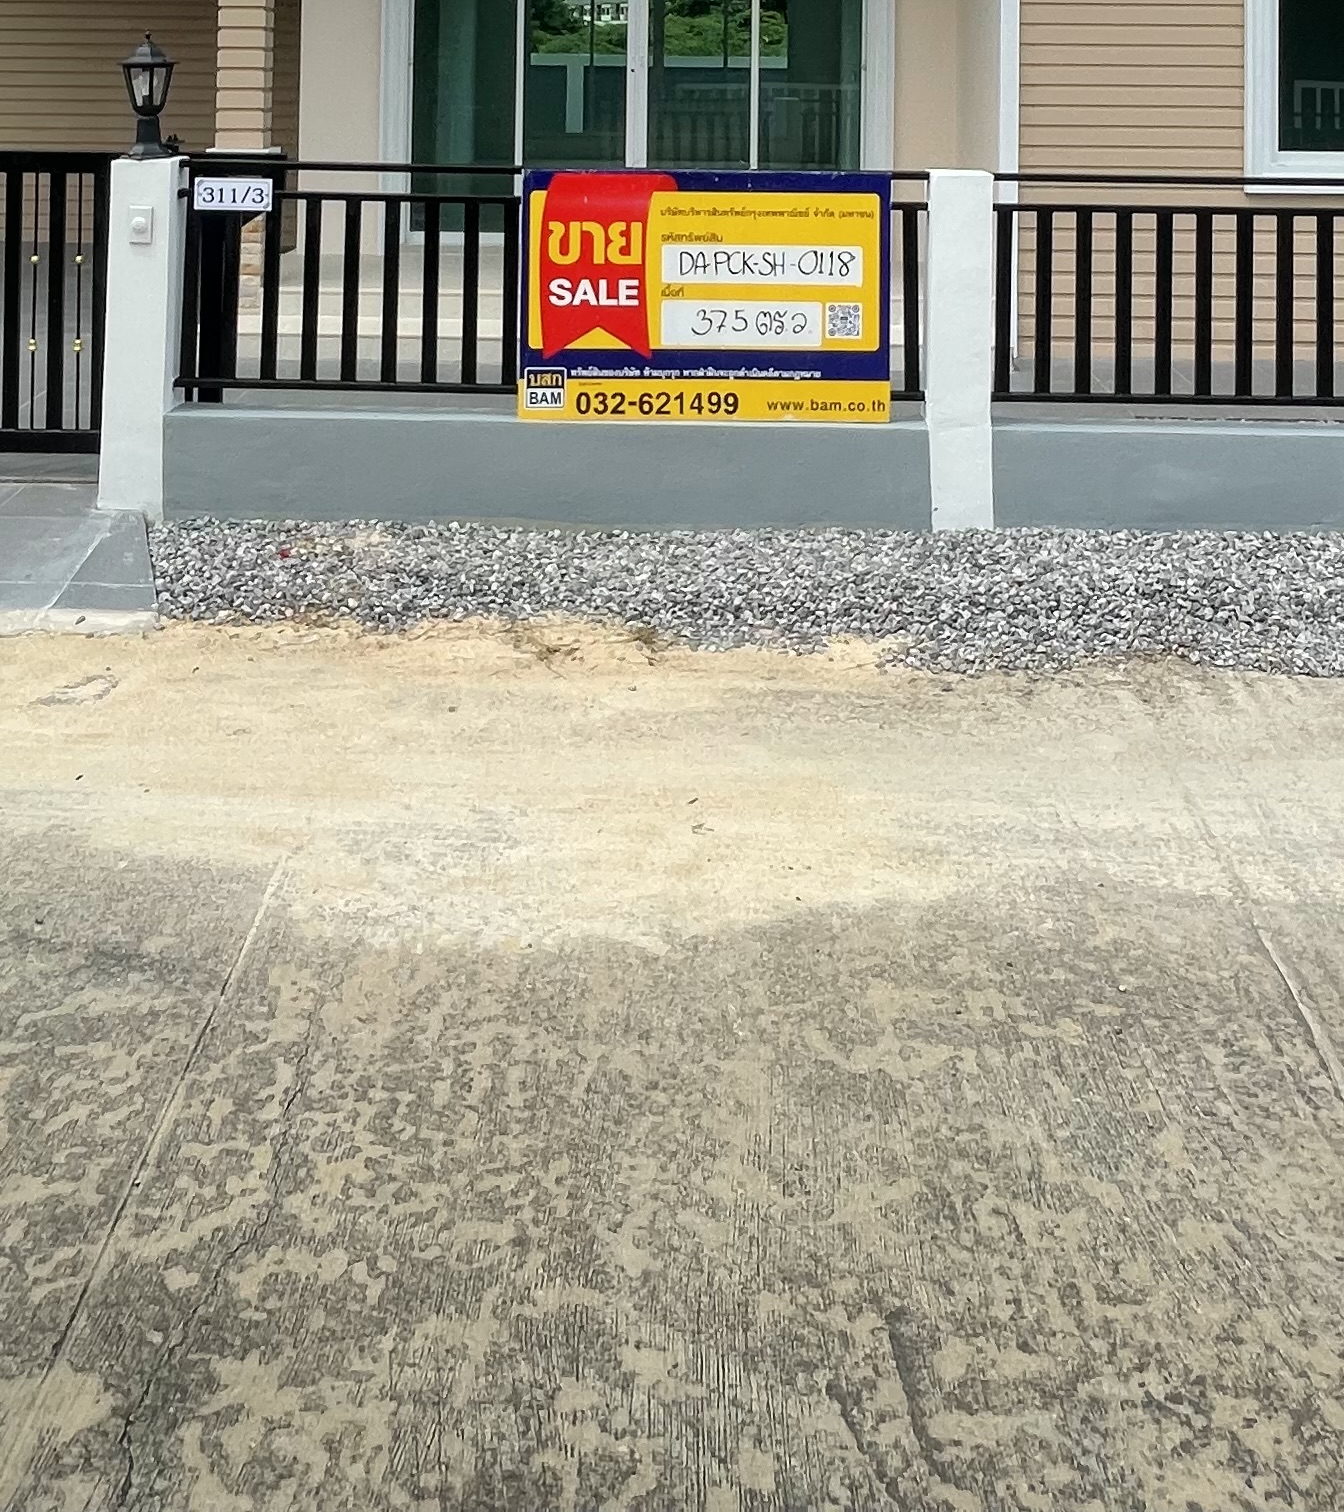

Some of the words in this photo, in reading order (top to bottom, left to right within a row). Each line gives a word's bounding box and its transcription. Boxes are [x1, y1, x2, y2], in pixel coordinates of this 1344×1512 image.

[202, 186, 265, 204] 311/3
[549, 221, 642, 265] ขาย
[549, 279, 639, 306] SALE
[529, 371, 563, 388] บสก
[529, 391, 562, 405] BAM
[575, 391, 739, 415] 032-621499
[767, 397, 886, 412] www.bam.co.th
